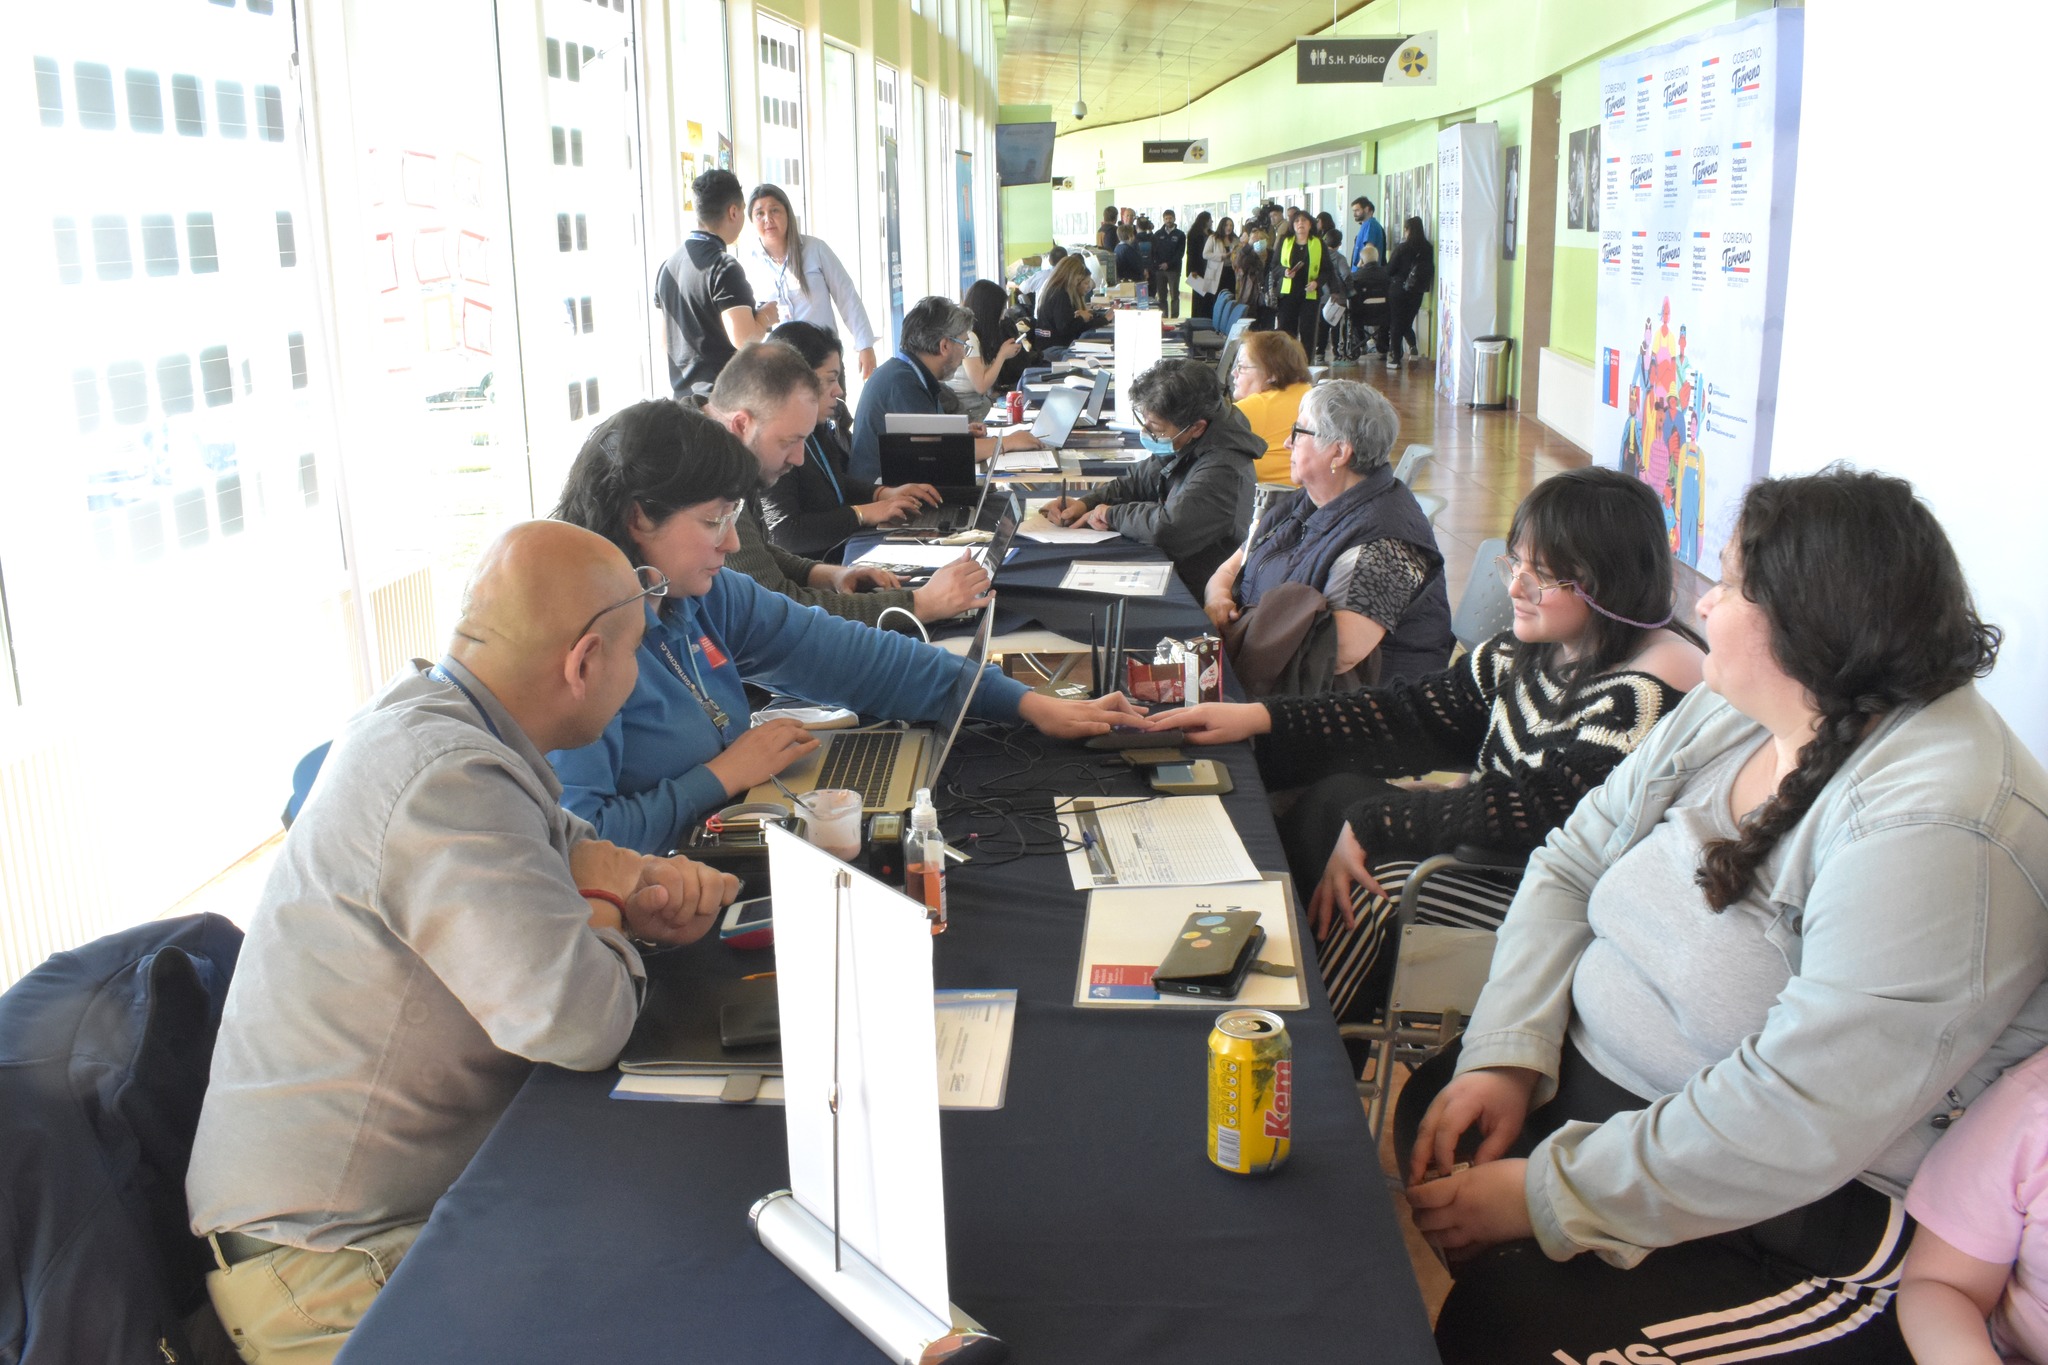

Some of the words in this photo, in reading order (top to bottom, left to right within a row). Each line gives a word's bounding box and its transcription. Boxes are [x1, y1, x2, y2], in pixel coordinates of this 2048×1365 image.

[1328, 55, 1346, 65] S.H.
[1349, 54, 1385, 64] Público
[1733, 46, 1762, 65] GOBIERNO
[1664, 65, 1689, 82] GOBIERNO
[1731, 64, 1760, 95] Terreno
[1605, 81, 1627, 94] GOBIERNO
[1663, 81, 1688, 109] Terreno
[1604, 96, 1626, 119] Terreno
[1630, 153, 1654, 165] GOBIERNO
[1693, 144, 1719, 158] GOBIERNO
[1630, 168, 1653, 191] Terreno
[1692, 161, 1718, 187] Terreno
[1657, 231, 1682, 241] GOBIERNO
[1722, 231, 1753, 244] GOBIERNO
[1656, 245, 1681, 269] Terreno
[1722, 247, 1751, 274] Terreno
[1264, 1059, 1291, 1139] Kem
